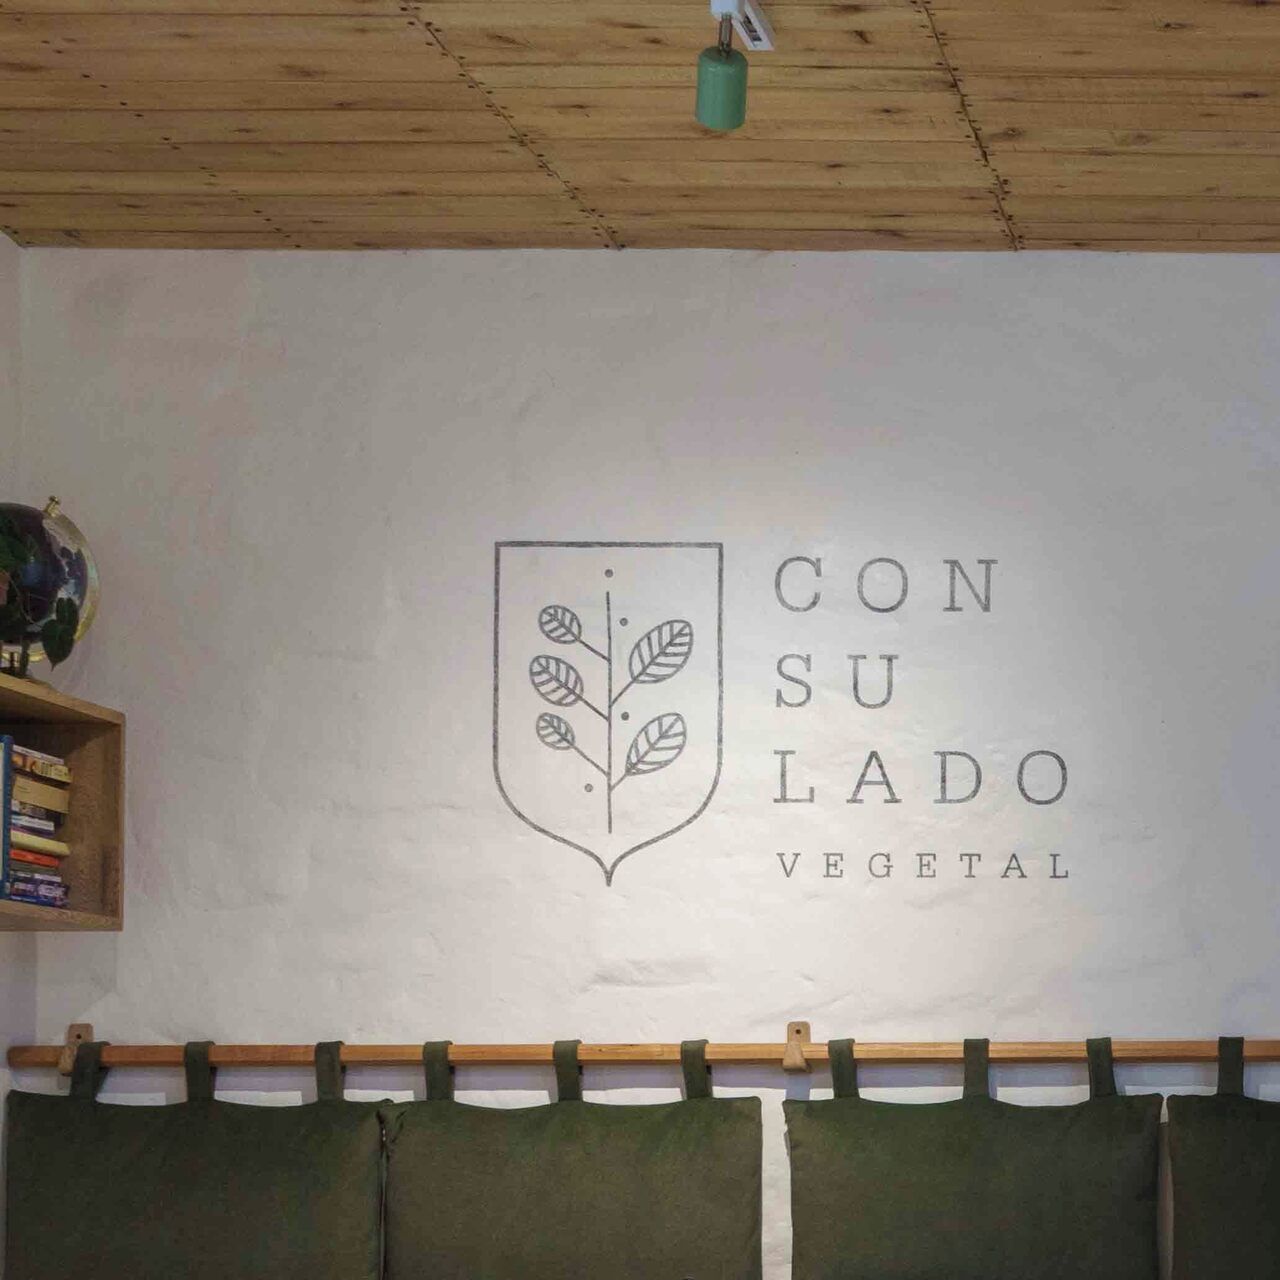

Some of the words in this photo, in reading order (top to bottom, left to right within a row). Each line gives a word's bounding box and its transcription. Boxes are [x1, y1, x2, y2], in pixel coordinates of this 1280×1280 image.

[773, 555, 998, 613] CON
[774, 653, 899, 709] SU
[772, 749, 1070, 806] LADO
[776, 853, 1070, 879] VEGETAL
